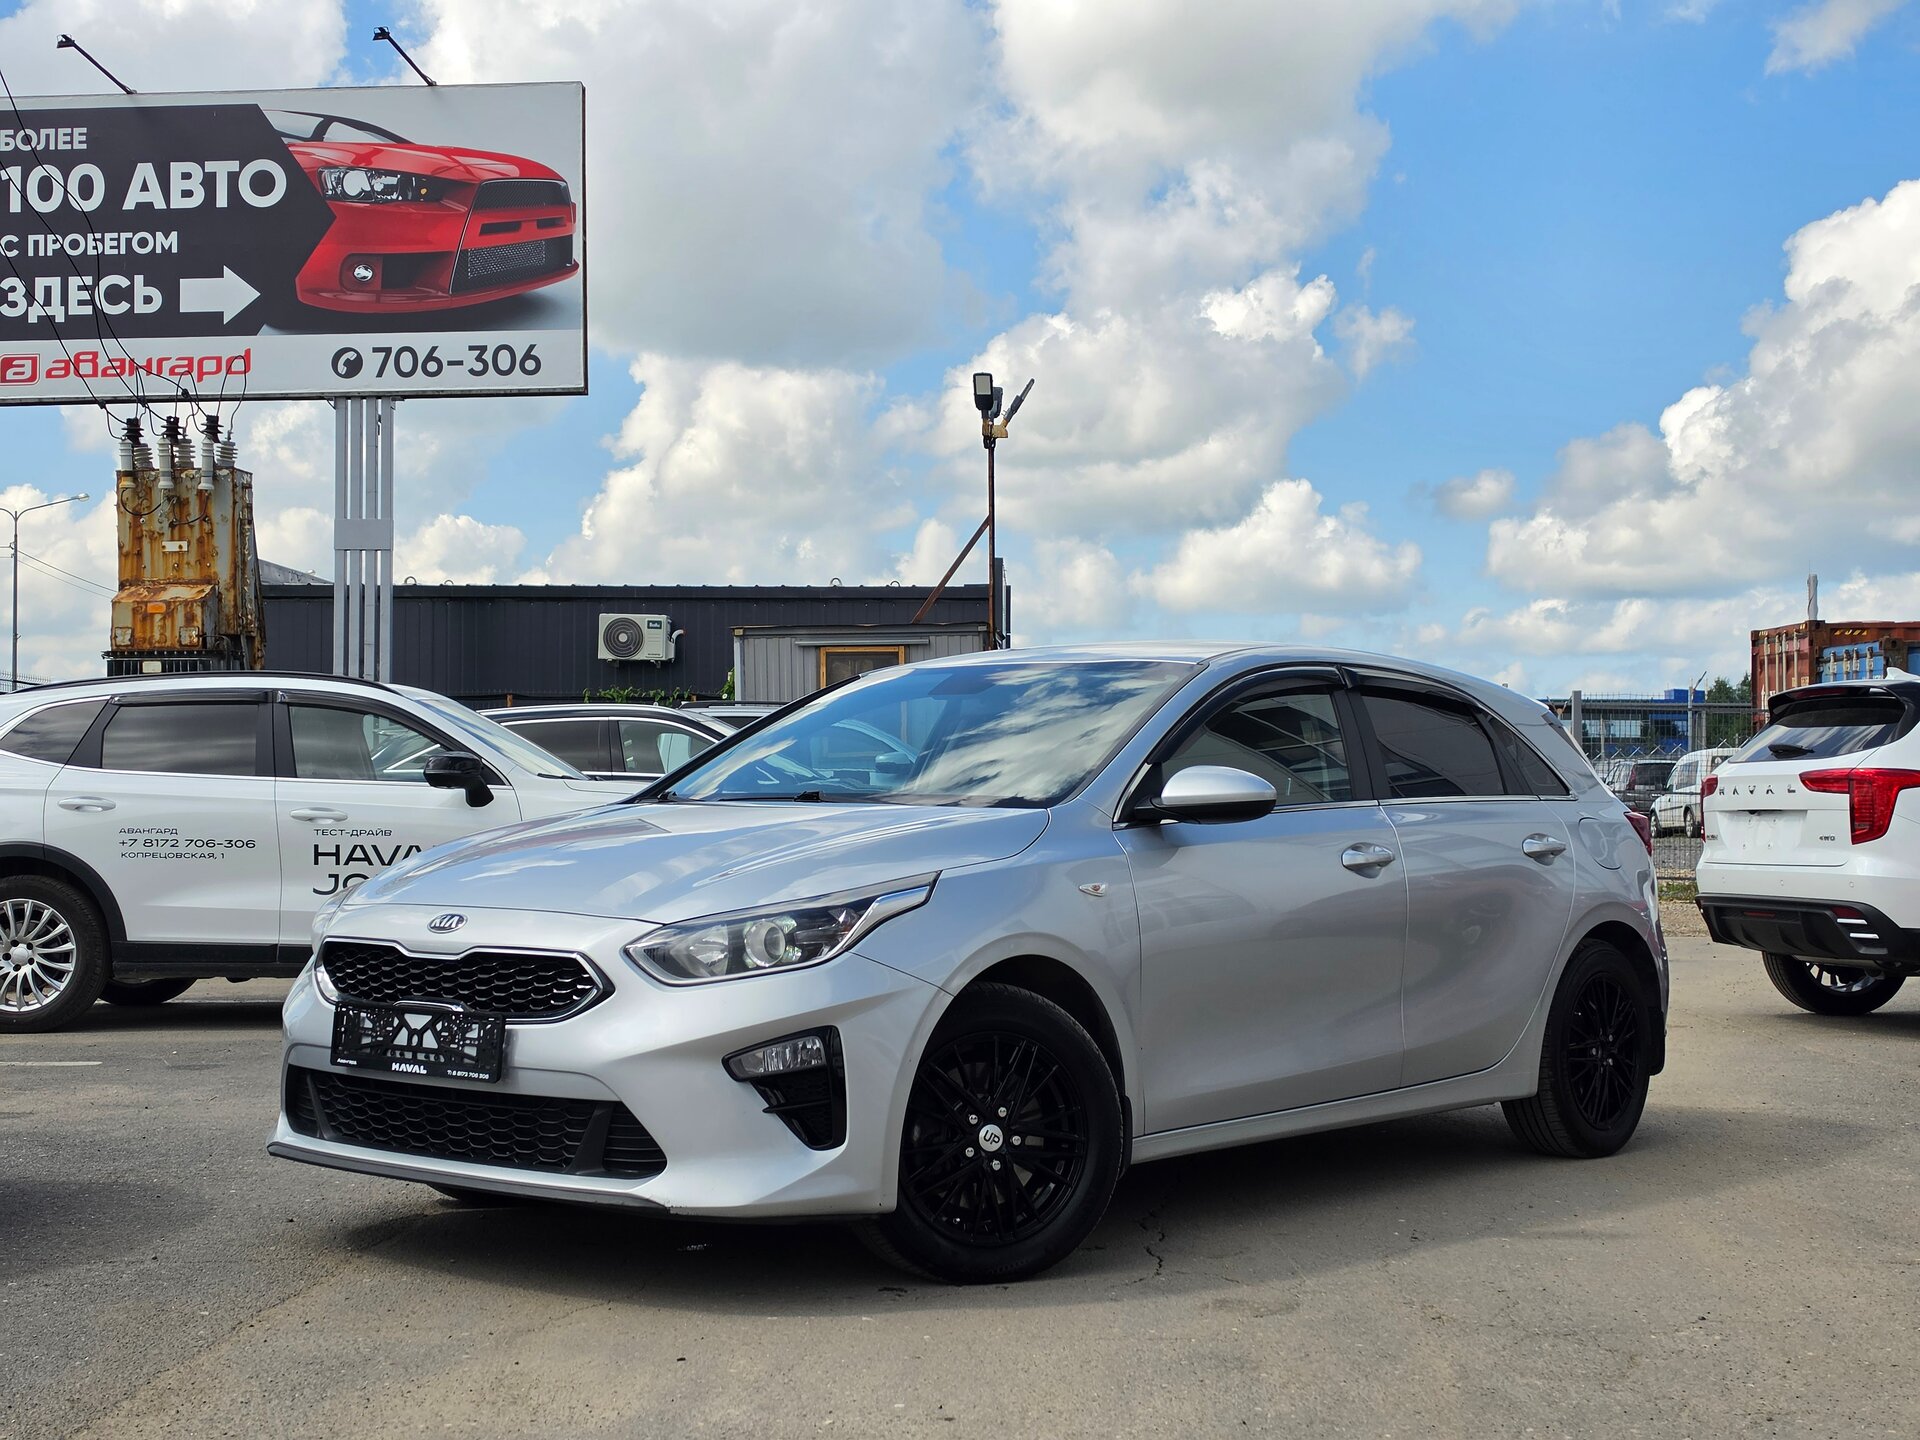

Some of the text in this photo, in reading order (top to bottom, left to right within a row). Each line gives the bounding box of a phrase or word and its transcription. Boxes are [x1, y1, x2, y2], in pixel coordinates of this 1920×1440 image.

[0, 127, 88, 152] БОЛЕЕ
[0, 158, 287, 213] 100 АВТО
[0, 230, 178, 258] С ПРОБЕГОМ
[0, 274, 163, 324] ЗДЕСЬ
[371, 343, 542, 379] 706-306
[118, 827, 179, 836] АВАНГАРД
[313, 827, 393, 842] ТЕСТ-ДРАЙВ
[118, 838, 257, 849] +7 8172 706-306
[120, 851, 218, 860] КОПРЕЦОВСКАЯ,
[430, 915, 461, 928] KIA
[391, 1062, 428, 1075] HAVAL
